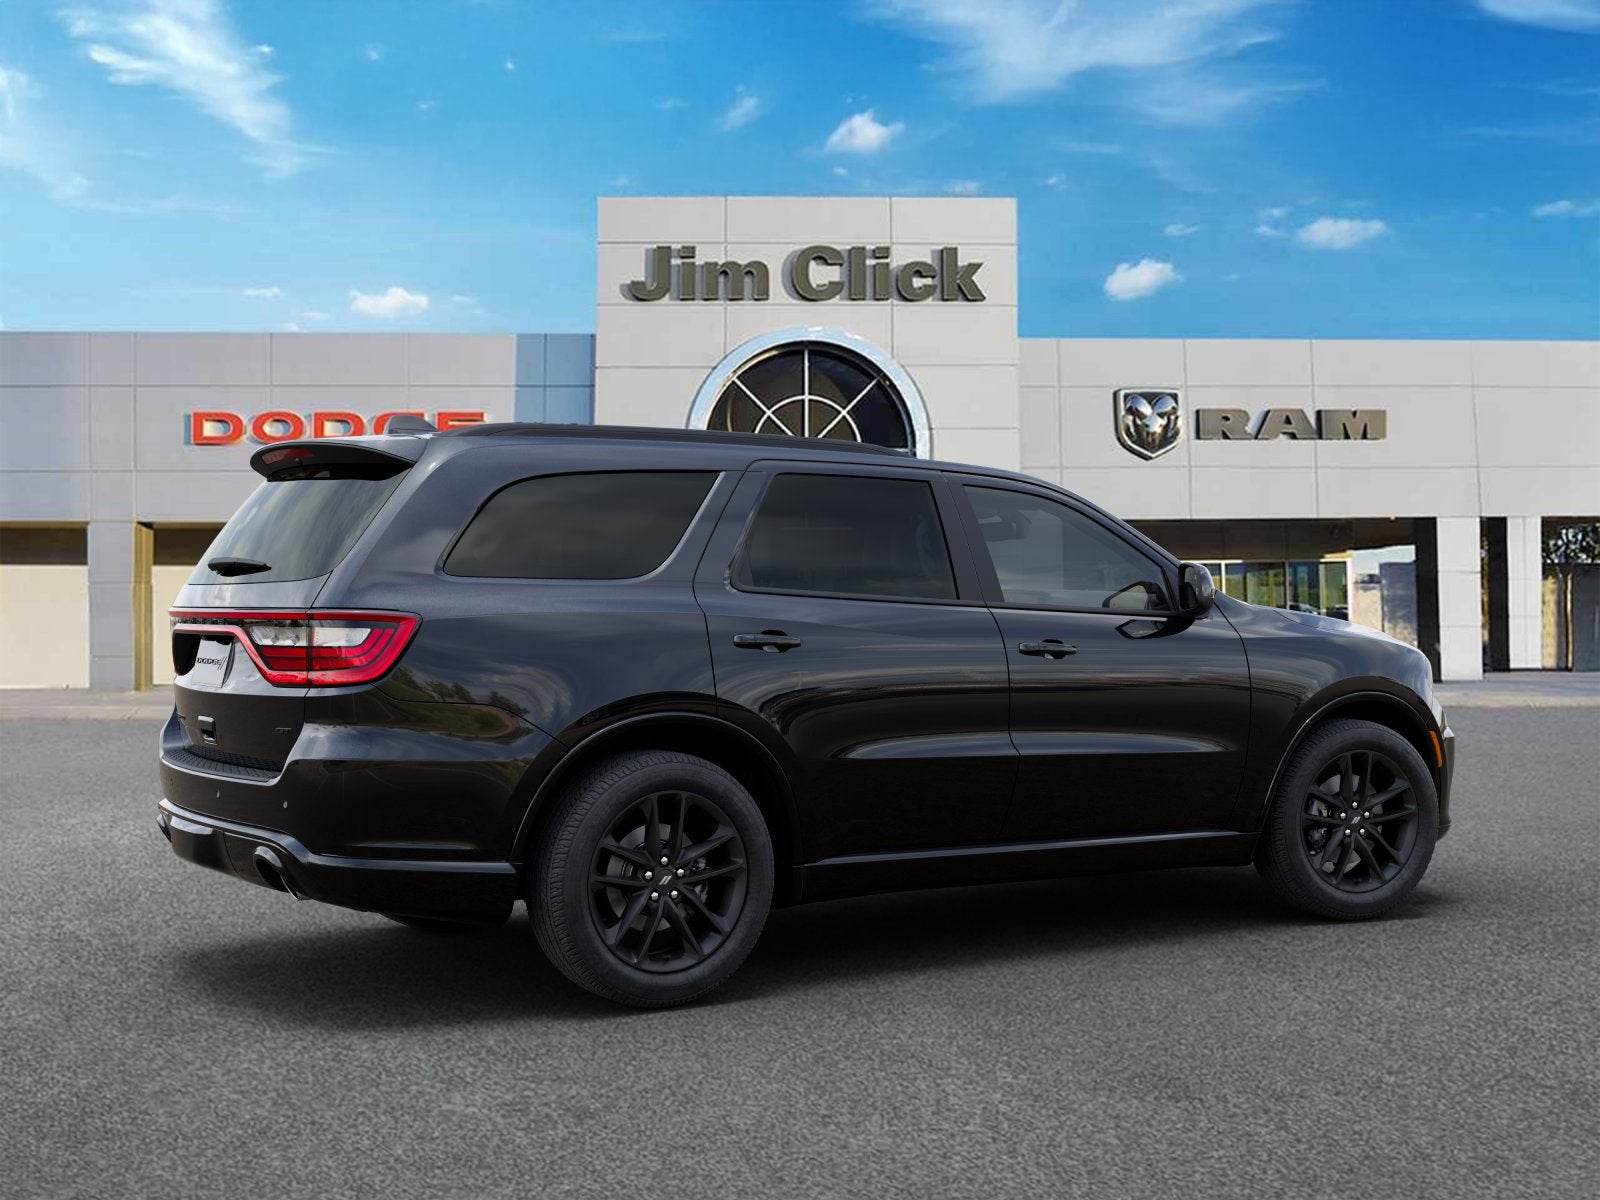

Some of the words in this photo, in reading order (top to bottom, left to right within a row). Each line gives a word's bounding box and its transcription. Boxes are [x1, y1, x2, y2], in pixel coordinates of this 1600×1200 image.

[623, 245, 770, 301] Jim
[787, 245, 986, 301] Click
[1195, 408, 1387, 440] RAM
